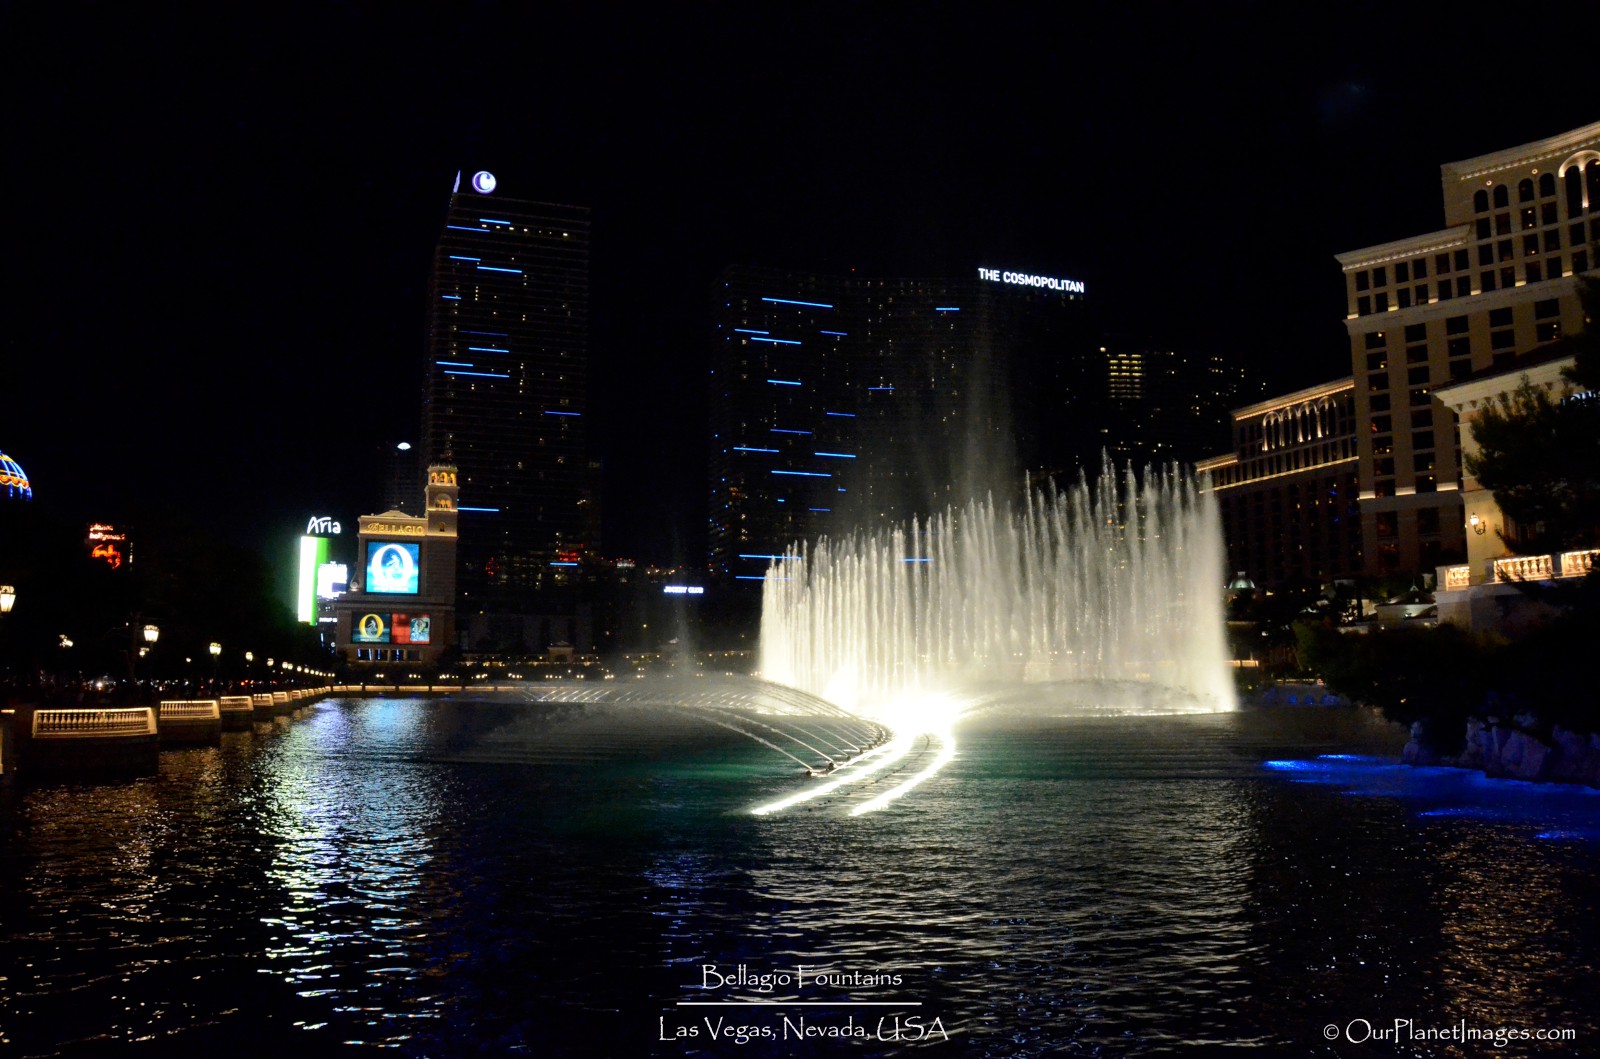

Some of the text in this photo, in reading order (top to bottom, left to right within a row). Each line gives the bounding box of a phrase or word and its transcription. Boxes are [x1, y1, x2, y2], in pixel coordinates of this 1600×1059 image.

[978, 267, 1085, 293] THE COSMOPOLITAN
[306, 516, 342, 534] Aria
[367, 522, 425, 534] BELLAGIO
